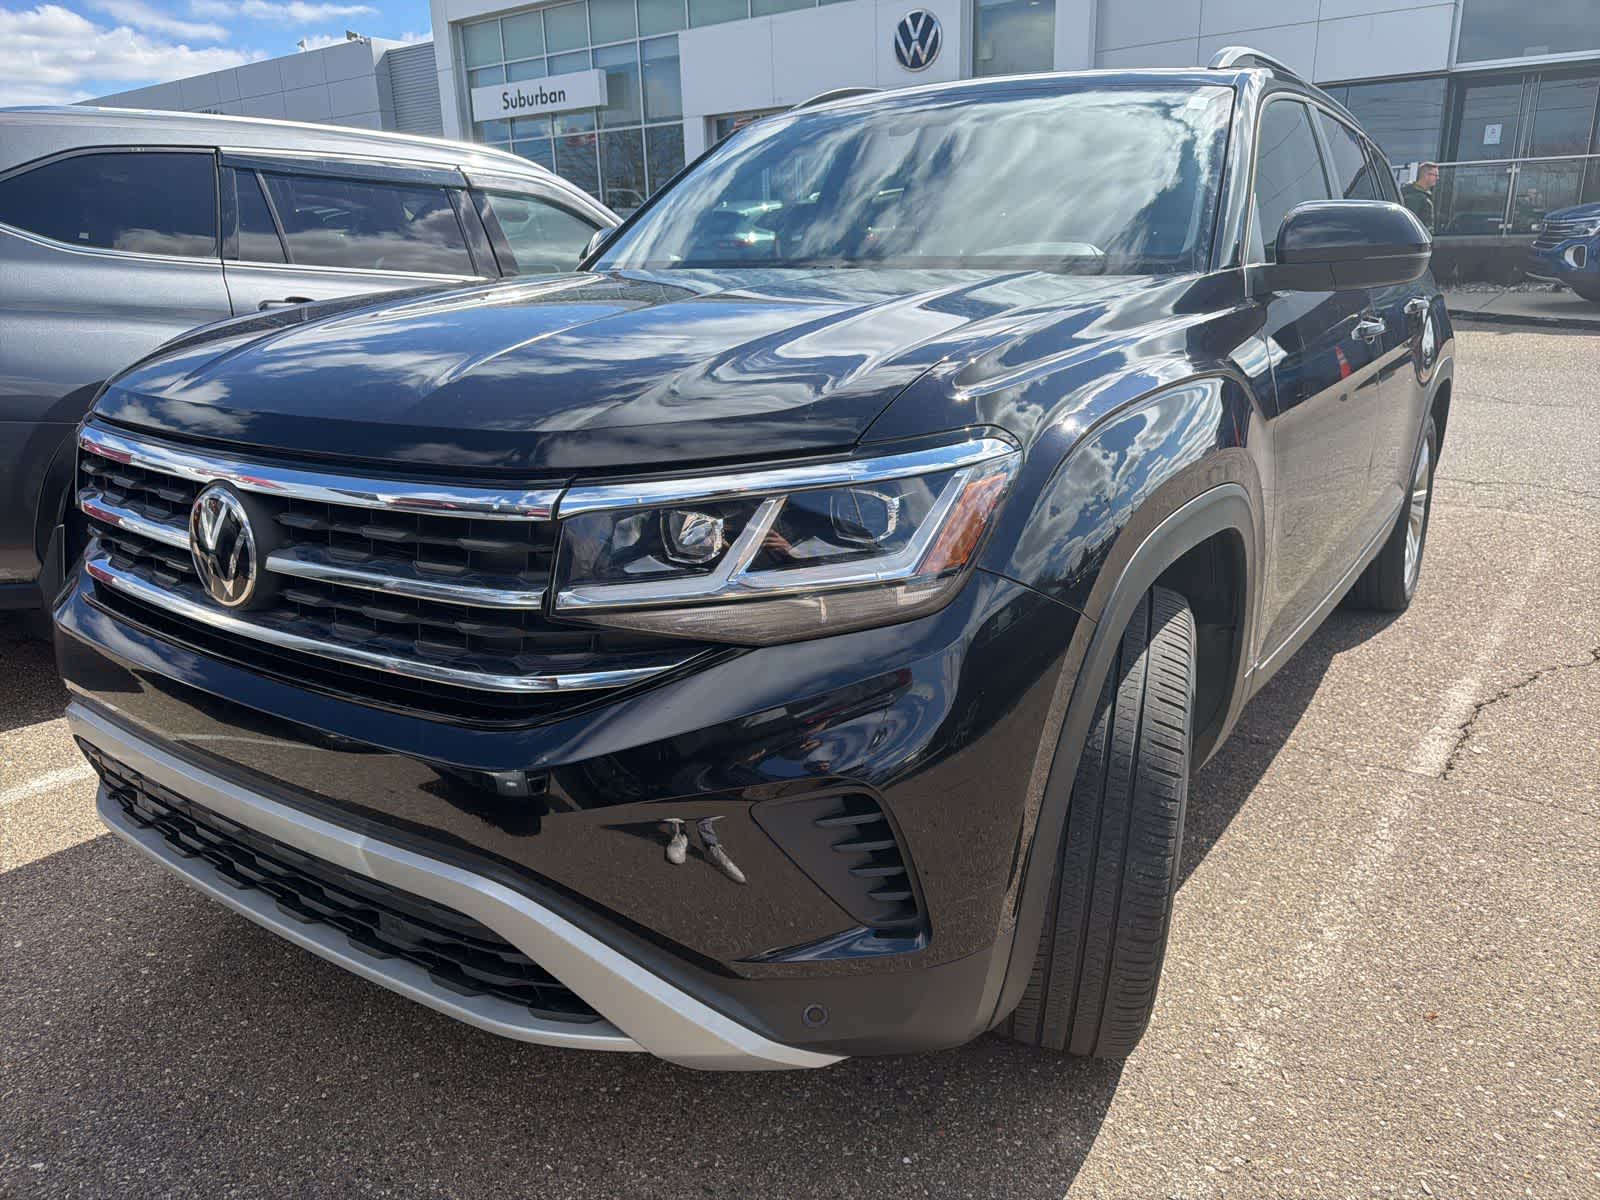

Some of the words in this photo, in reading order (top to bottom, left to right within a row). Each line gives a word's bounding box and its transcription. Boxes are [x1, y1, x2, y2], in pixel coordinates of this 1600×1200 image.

[895, 10, 941, 70] VW
[502, 86, 566, 110] Suburban
[190, 490, 254, 604] VW
